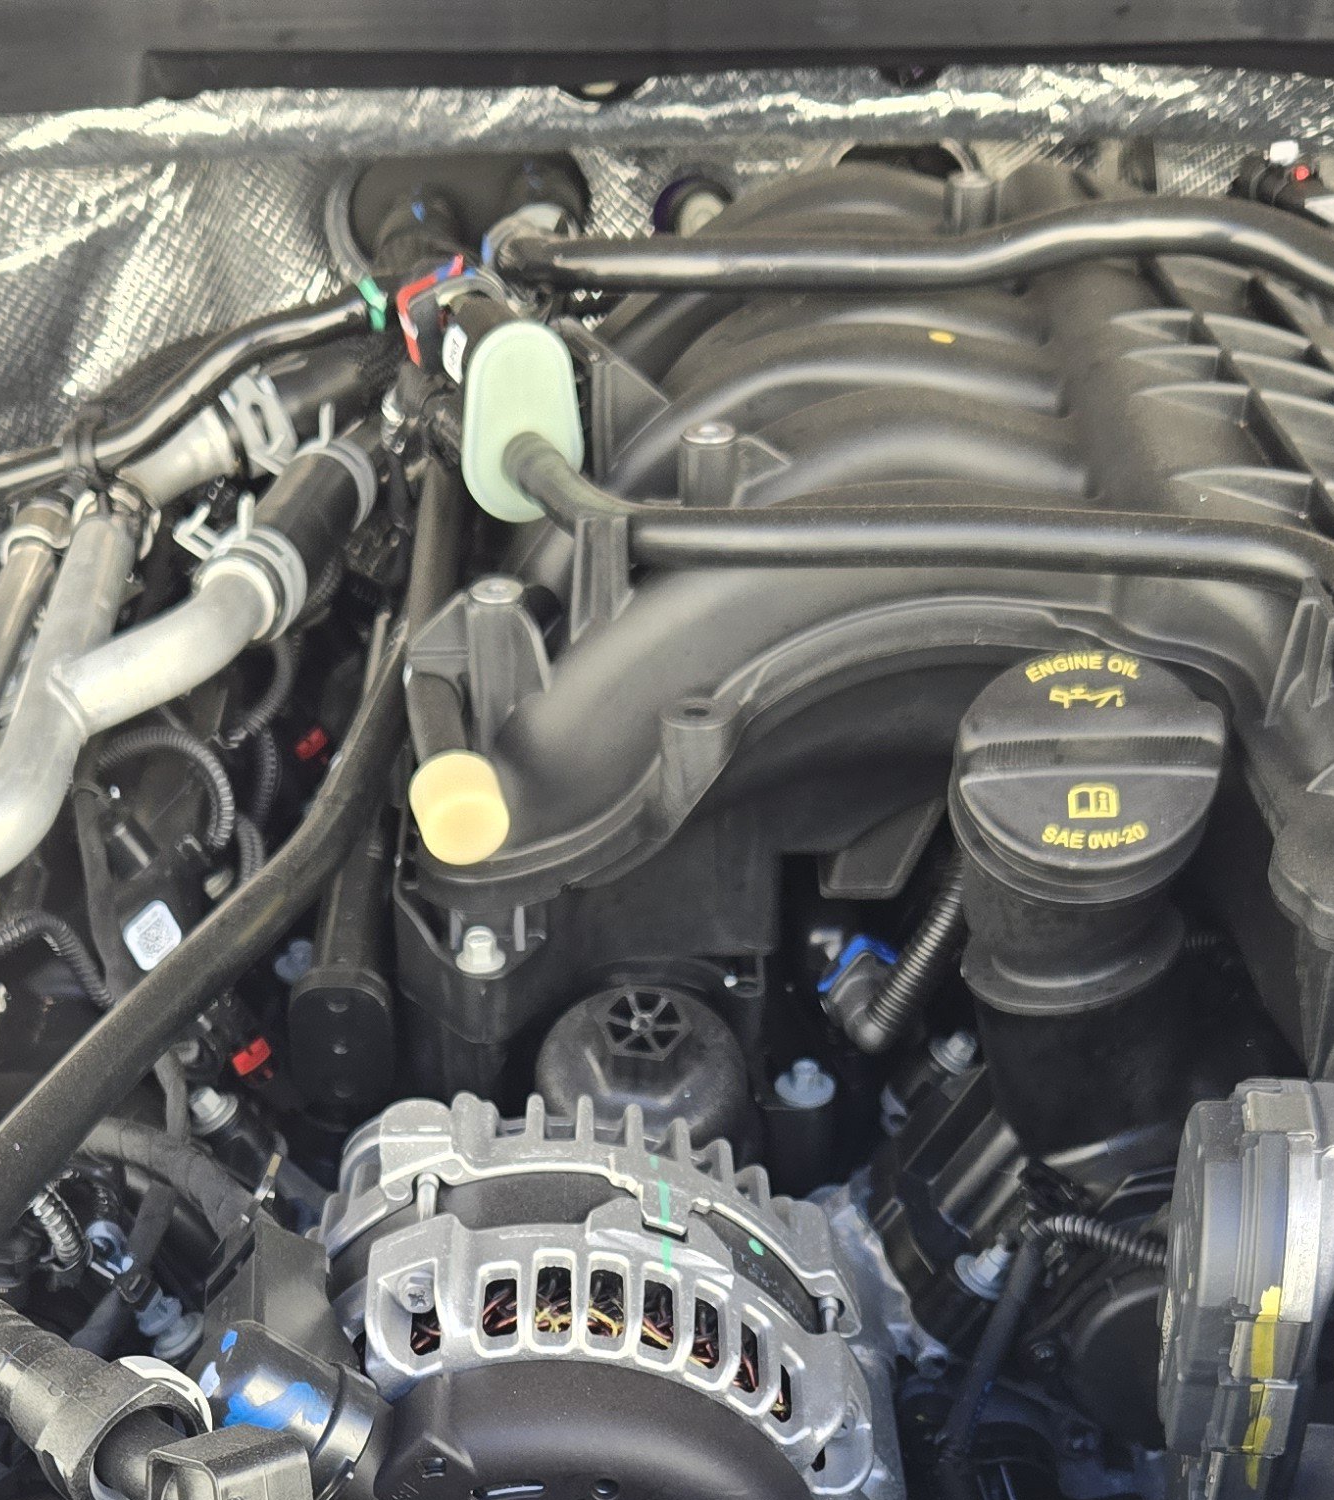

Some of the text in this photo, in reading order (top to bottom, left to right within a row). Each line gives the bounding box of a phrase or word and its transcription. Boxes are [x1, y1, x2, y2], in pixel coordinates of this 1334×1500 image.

[1025, 654, 1140, 683] ENGINE OIL
[1042, 822, 1147, 849] SAE 0W-20
